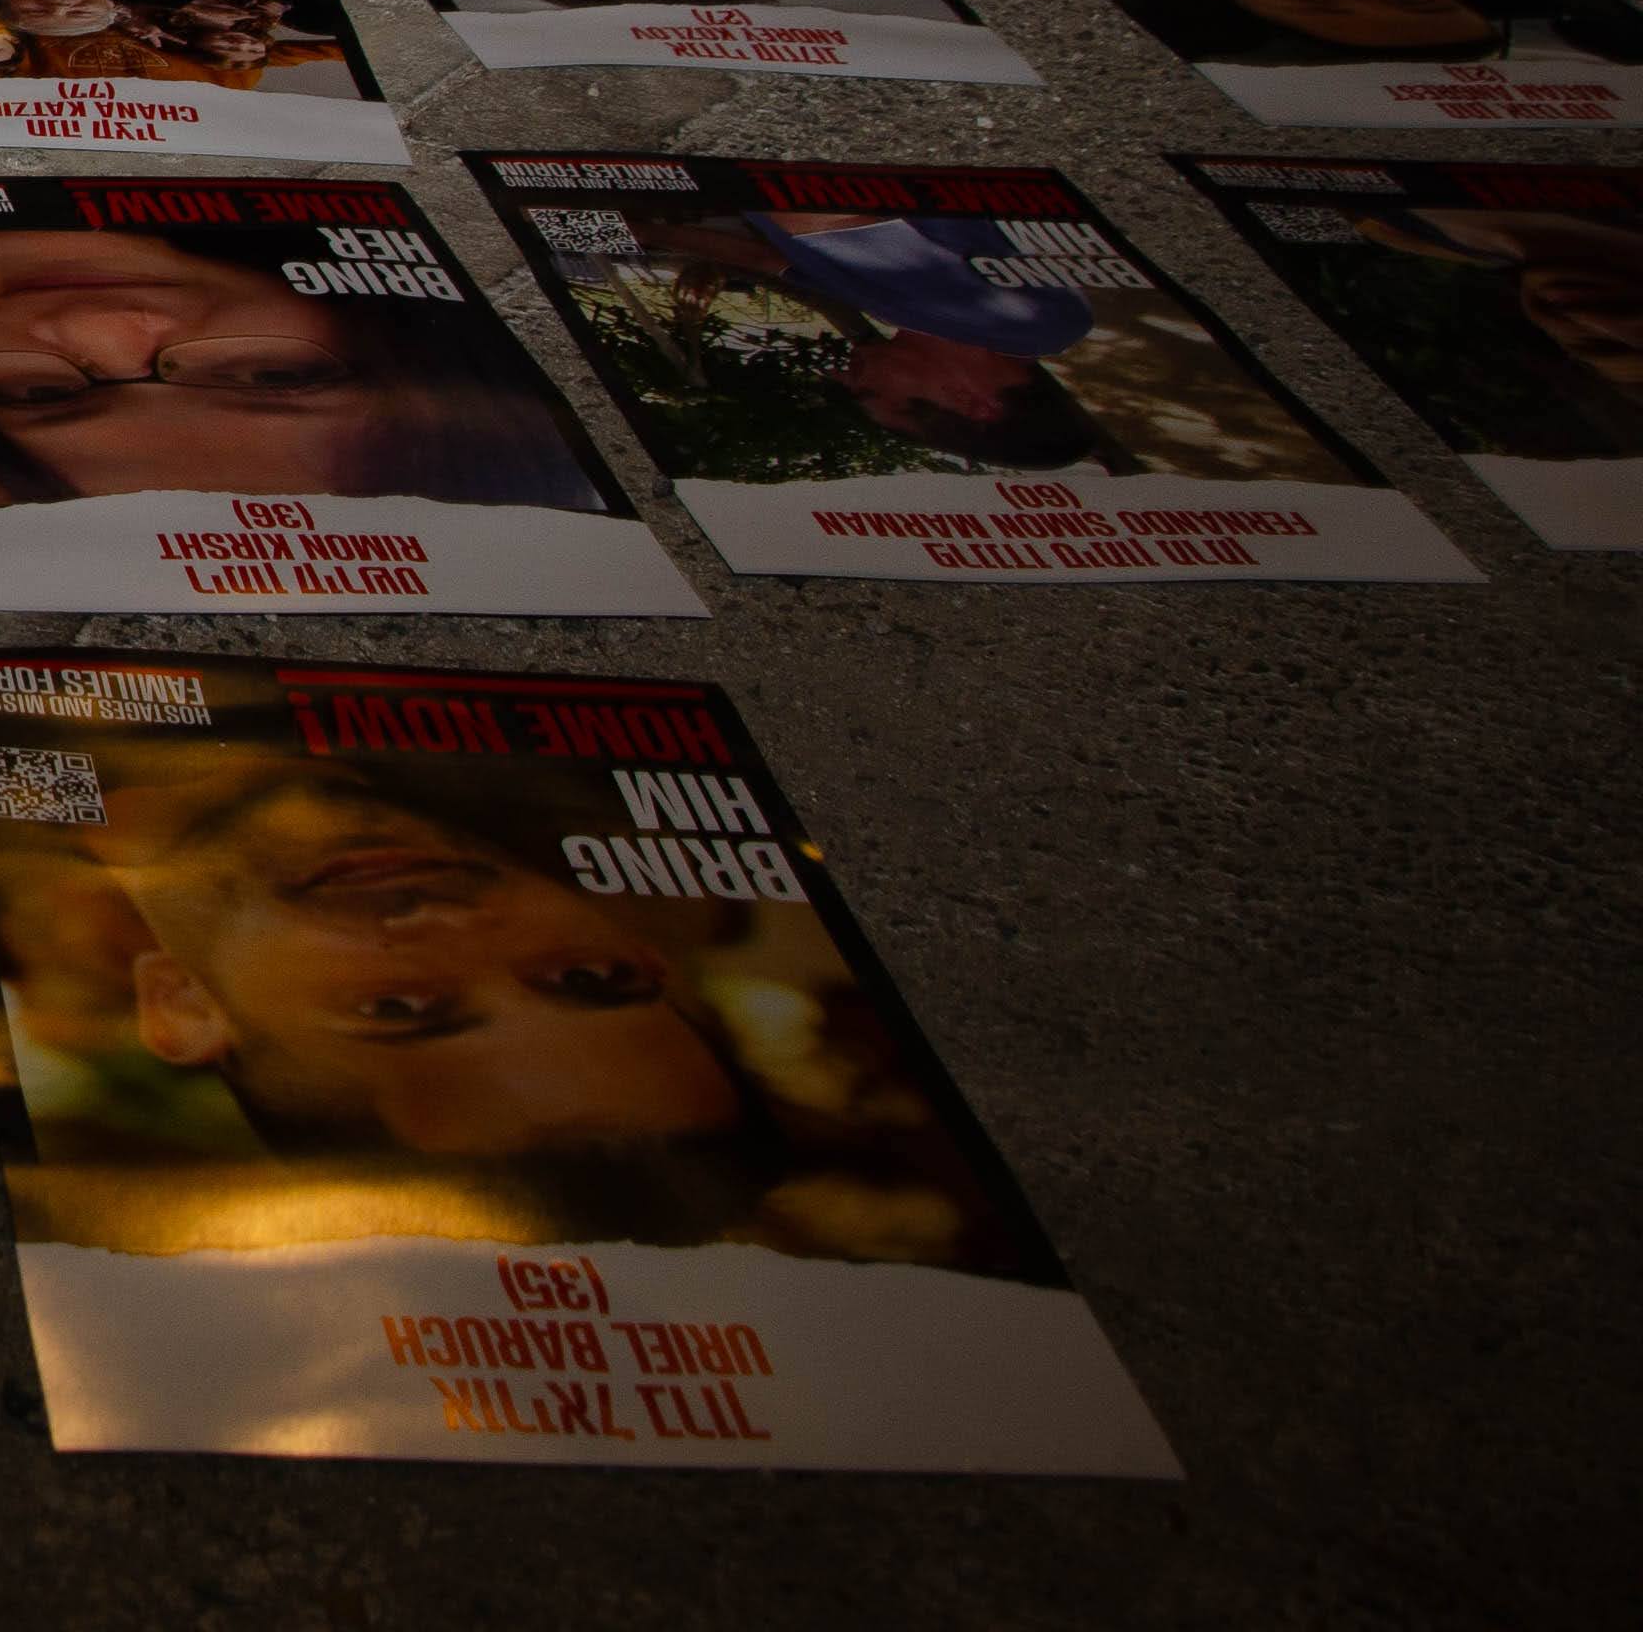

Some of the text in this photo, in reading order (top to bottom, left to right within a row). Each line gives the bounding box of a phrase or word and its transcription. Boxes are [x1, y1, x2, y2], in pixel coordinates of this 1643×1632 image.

[58, 81, 116, 99] (77)
[92, 99, 199, 123] CHANA
[71, 189, 411, 230] HOME NOW!
[317, 226, 437, 262] HER
[994, 218, 1128, 257] HIM
[282, 261, 464, 302] BRING
[966, 256, 1156, 290] BRING
[994, 481, 1082, 510] (60)
[231, 499, 313, 532] (36)
[810, 509, 1317, 539] FERNANDO SIMON MARMAN
[157, 533, 427, 563] RIMON KIRSHT
[184, 562, 429, 594] רימון קירשט
[62, 666, 206, 703] FAMILIES
[45, 692, 93, 720] AND
[97, 692, 212, 725] HOSTAGES
[289, 692, 731, 764] HOME NOW!
[611, 769, 771, 834] HIM
[563, 834, 808, 901] BRING
[497, 1256, 609, 1313] (35)
[384, 1315, 773, 1376] URIEL BARUCH
[430, 1378, 771, 1441] אוריאל ברוך
